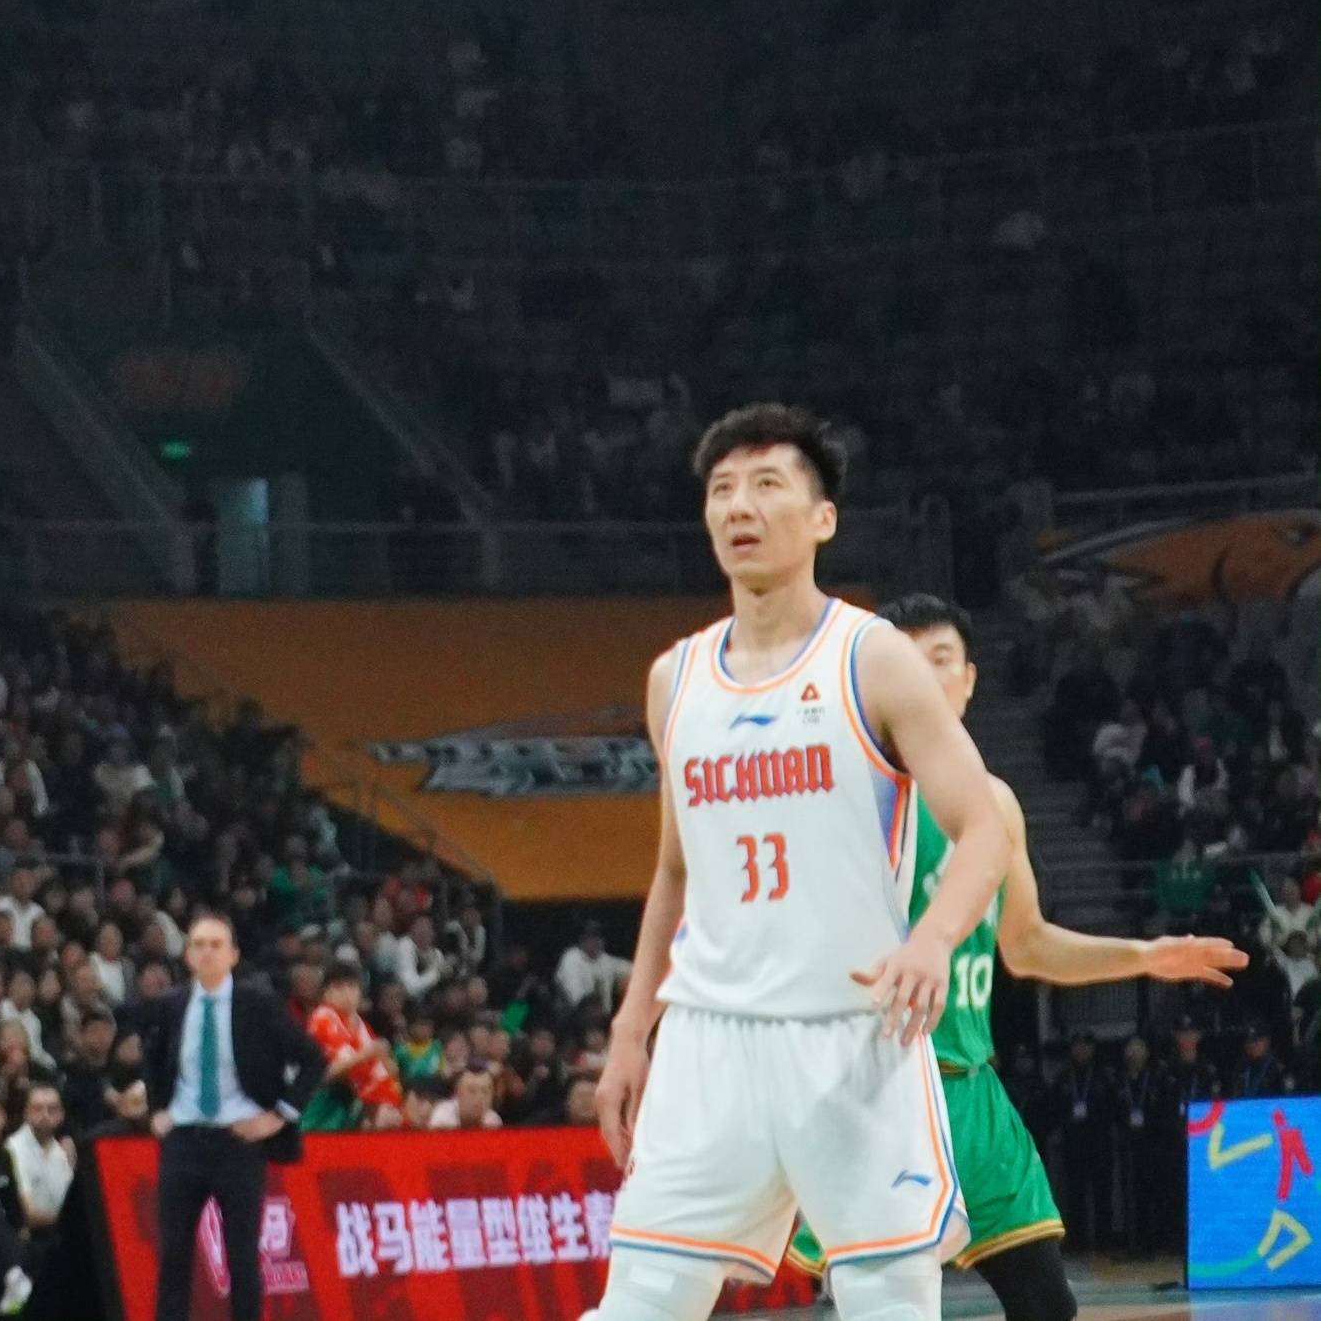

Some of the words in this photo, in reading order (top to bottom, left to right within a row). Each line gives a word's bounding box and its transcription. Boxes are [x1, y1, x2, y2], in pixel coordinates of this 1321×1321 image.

[684, 743, 835, 807] SICHUAN
[736, 832, 790, 904] 33
[955, 953, 994, 1010] 10
[336, 1189, 615, 1278] 战马能量型维生素
